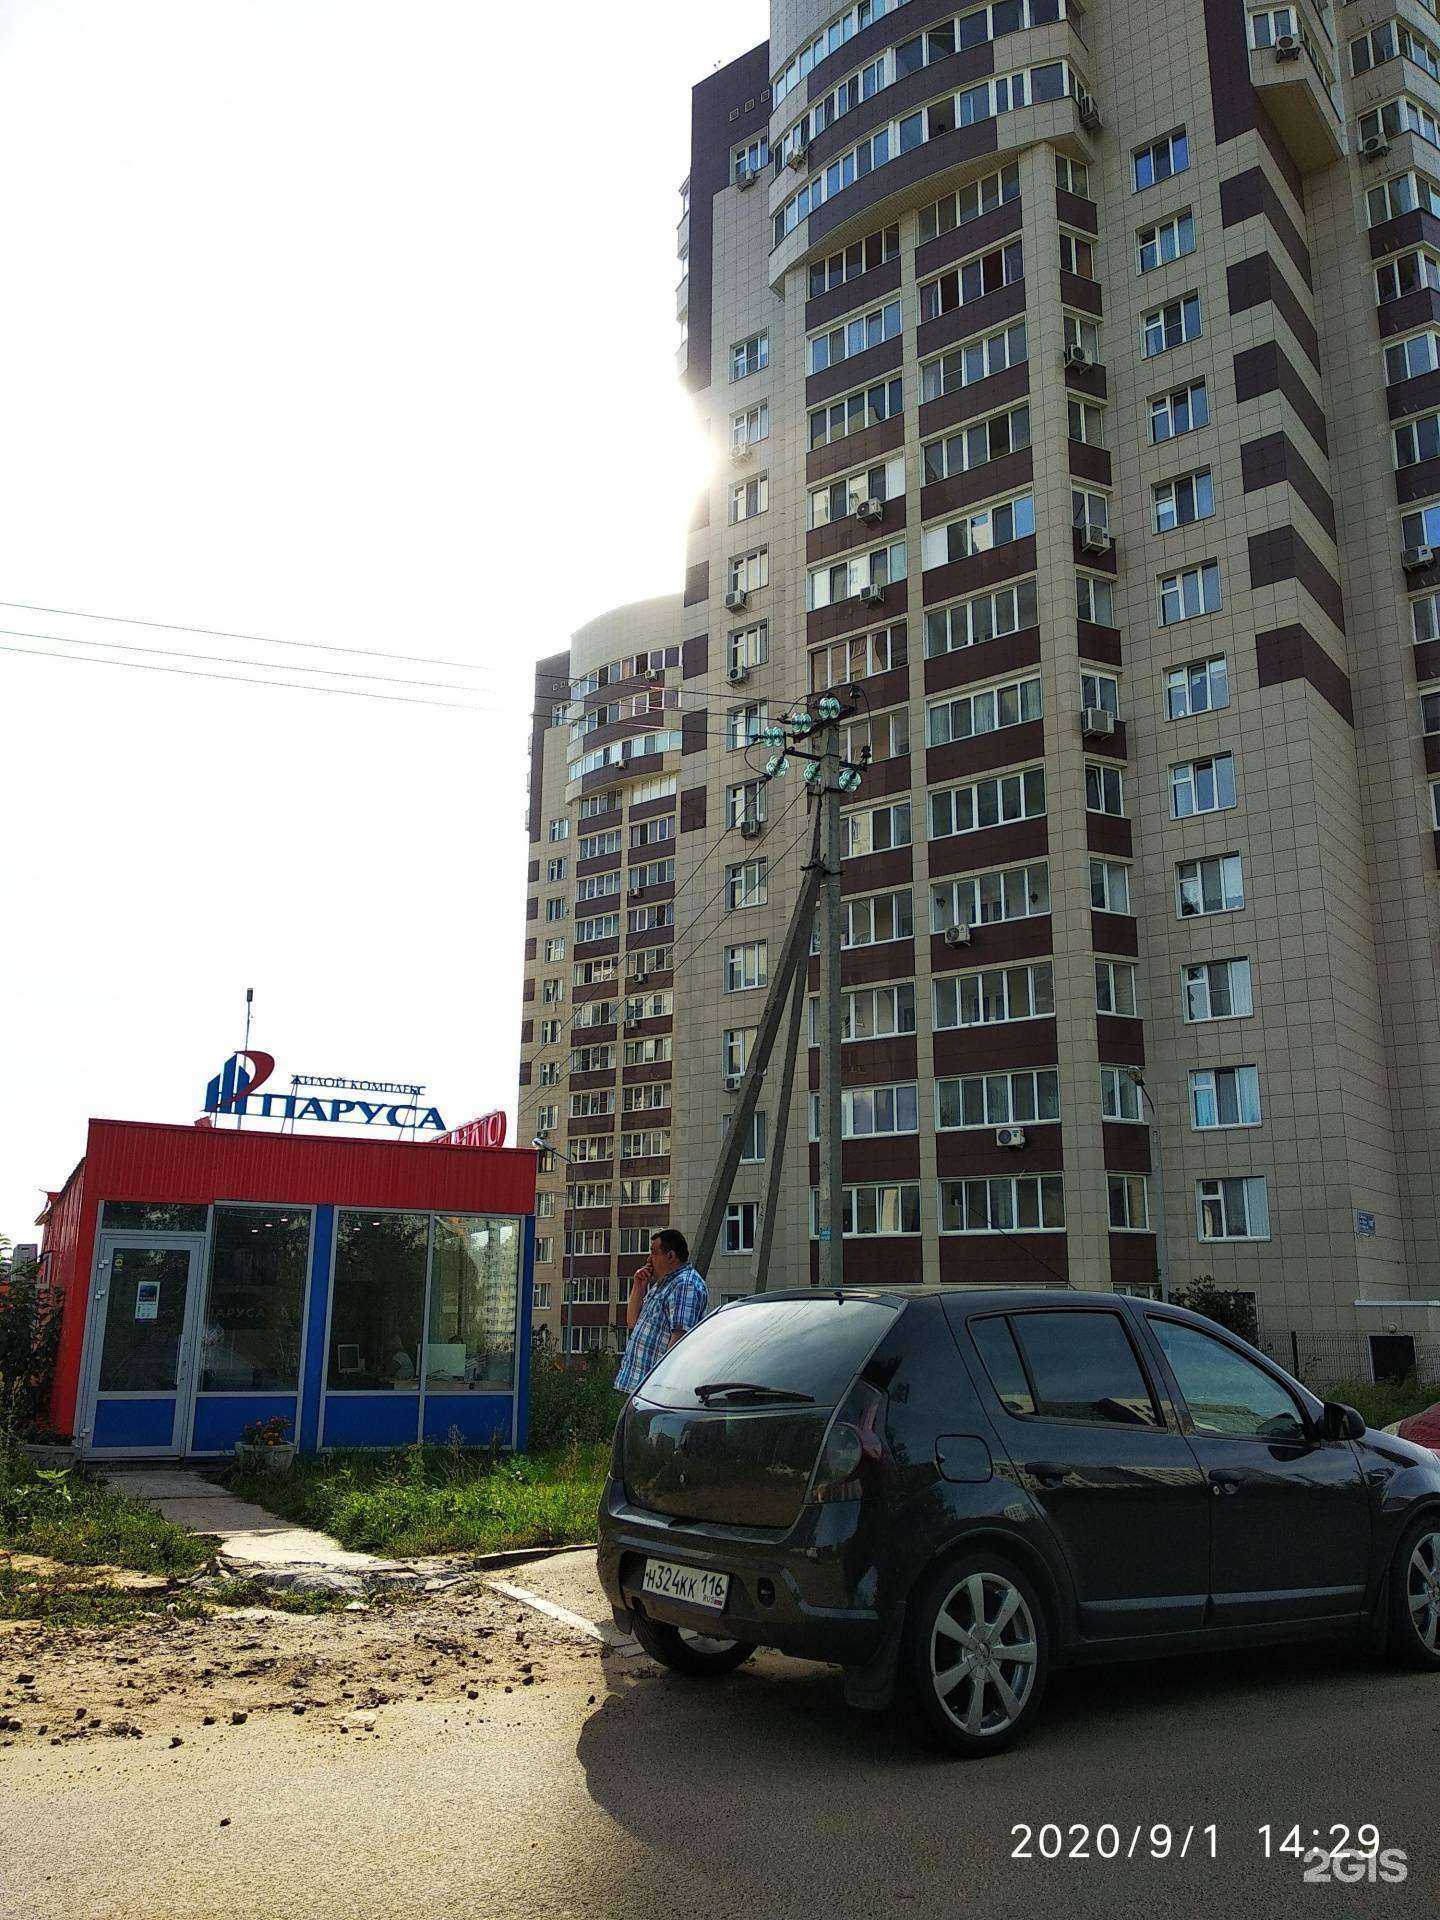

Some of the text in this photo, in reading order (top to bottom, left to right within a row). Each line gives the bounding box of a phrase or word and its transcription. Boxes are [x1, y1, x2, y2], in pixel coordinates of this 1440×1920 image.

[291, 1074, 426, 1095] ЖИЛОЙ КОМПЛЕКС
[262, 1094, 446, 1130] ПАРУСА
[701, 1573, 723, 1597] 116
